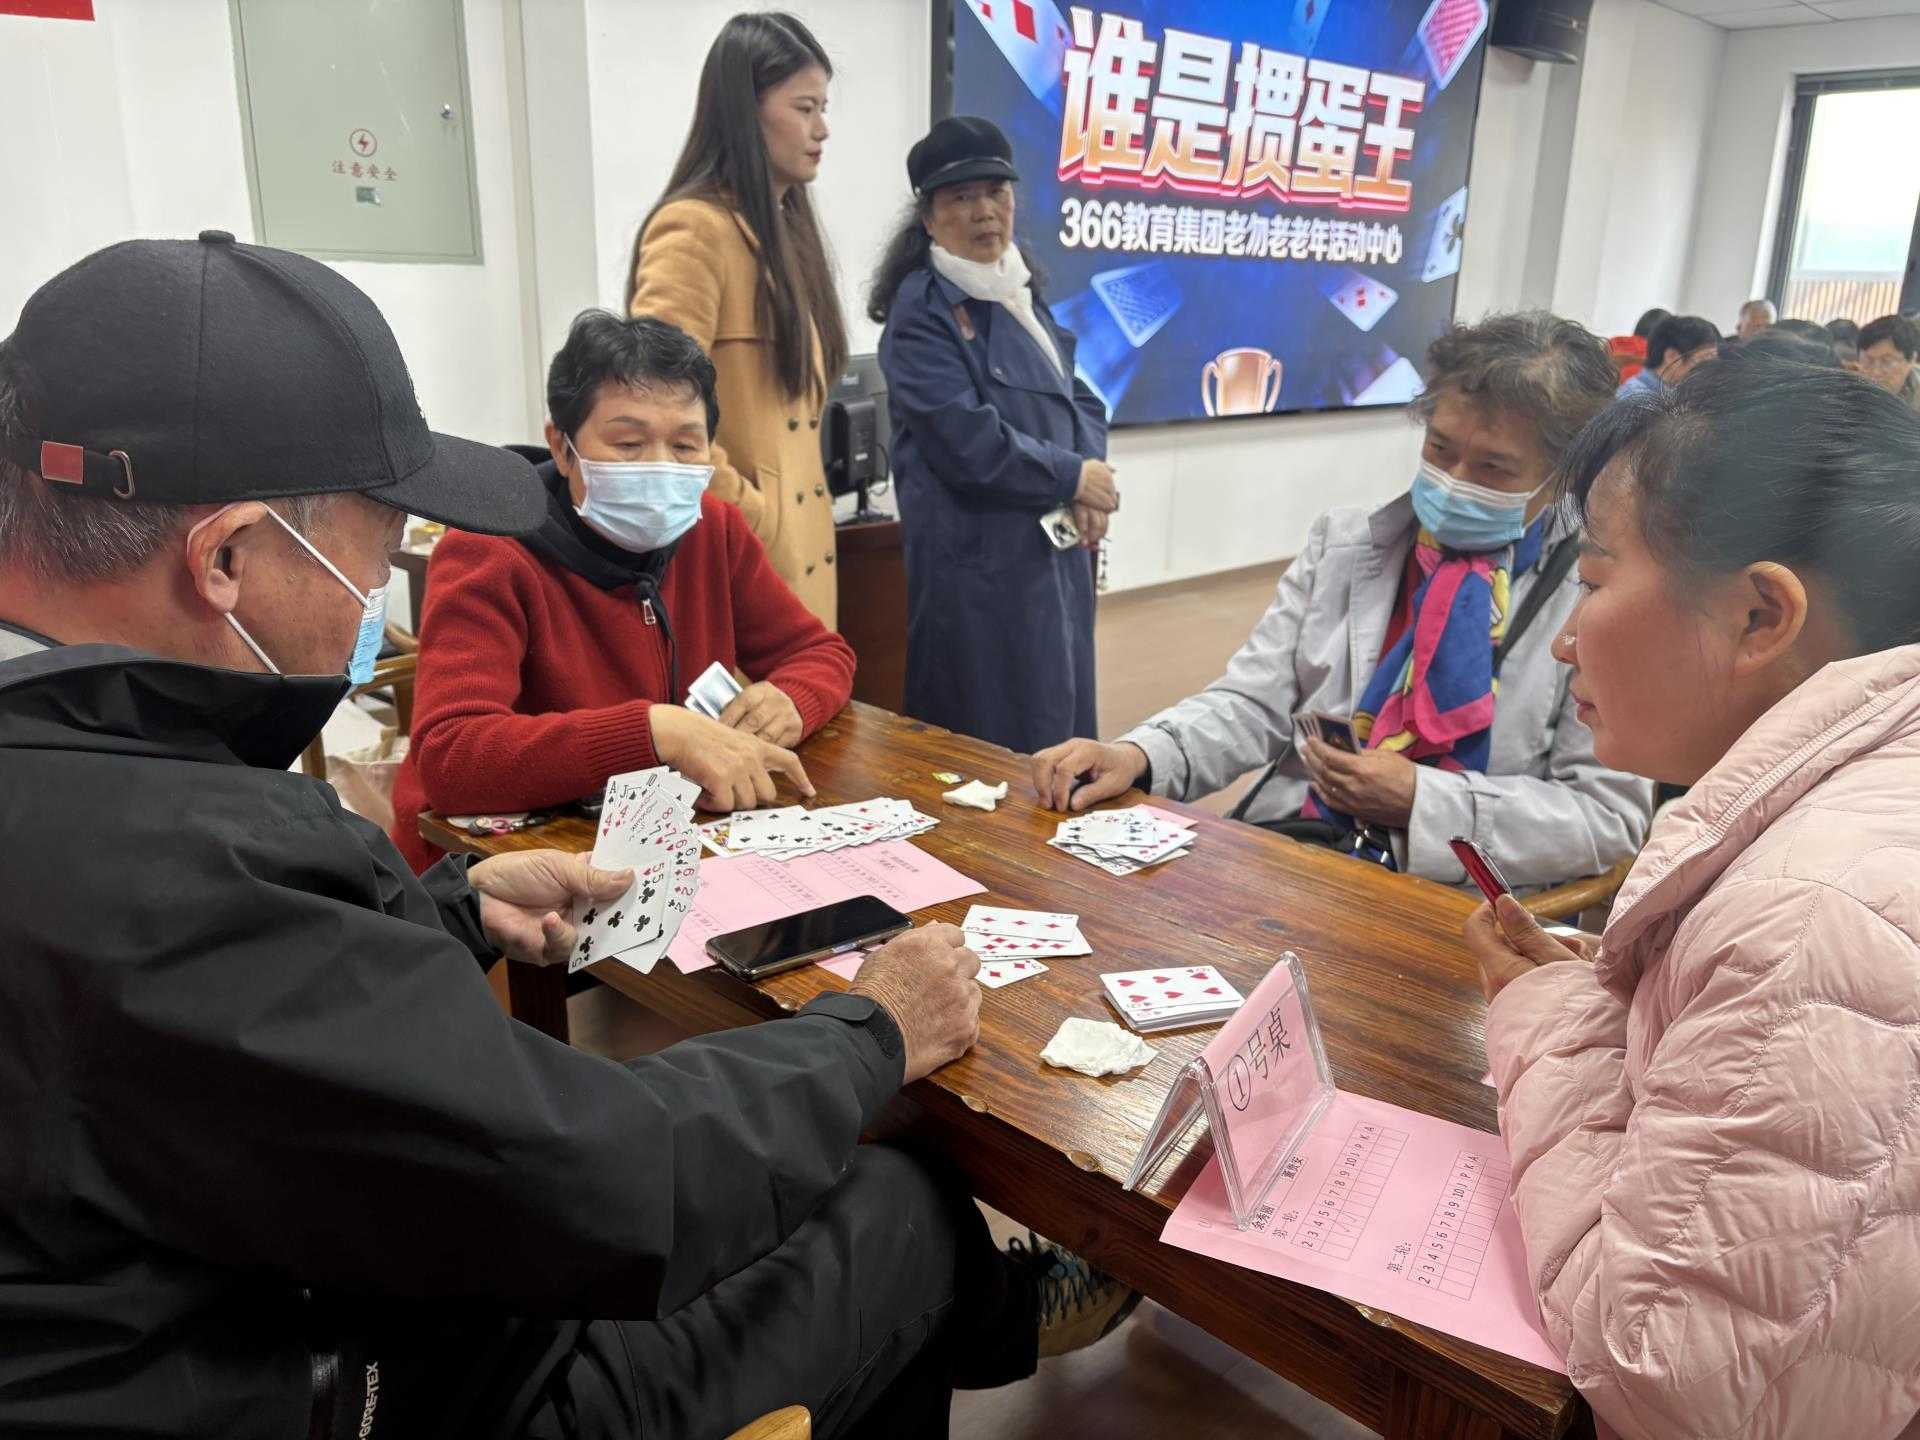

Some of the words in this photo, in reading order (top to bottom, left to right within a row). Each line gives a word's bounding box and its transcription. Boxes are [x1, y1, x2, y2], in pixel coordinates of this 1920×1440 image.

[1058, 6, 1425, 208] 谁是掼蛋王
[331, 160, 397, 181] 注意安全
[1059, 197, 1403, 264] 366教育集团老勿老老年活动中心
[609, 781, 616, 794] A
[620, 784, 629, 798] J
[620, 804, 629, 818] 4
[662, 807, 673, 820] 8
[605, 813, 613, 826] 4
[649, 826, 661, 836] 7
[664, 827, 677, 838] 7
[675, 840, 688, 849] 6
[685, 848, 697, 856] 6
[652, 862, 664, 873] 5
[683, 868, 695, 877] 6
[653, 873, 664, 884] 5
[681, 887, 694, 896] 2
[674, 902, 687, 913] 2
